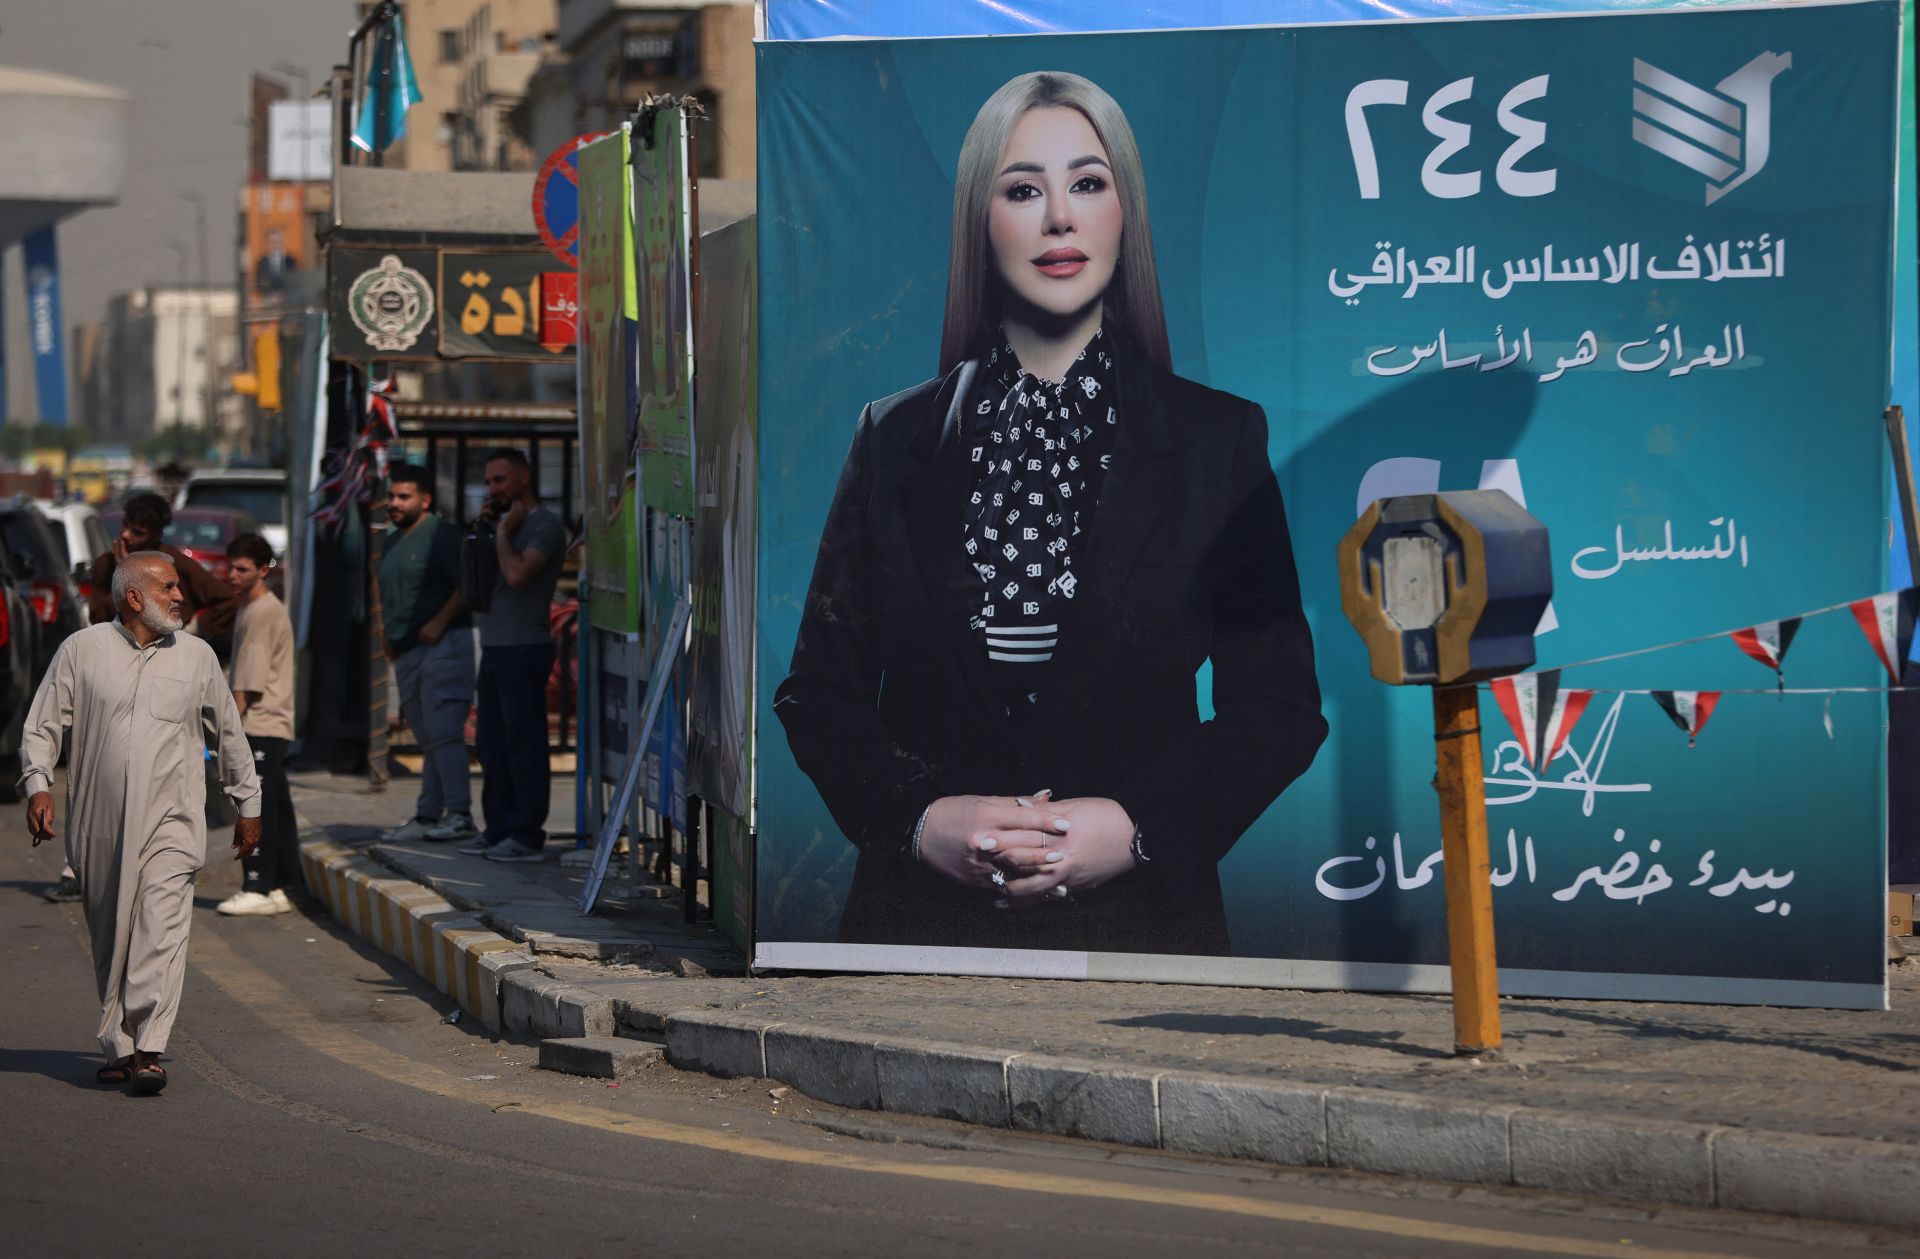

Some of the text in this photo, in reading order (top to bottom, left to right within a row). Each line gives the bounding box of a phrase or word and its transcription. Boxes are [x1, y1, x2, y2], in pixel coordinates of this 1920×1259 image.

[1344, 74, 1557, 199] ٢٤٤
[458, 270, 540, 337] ادة
[546, 291, 578, 318] وف
[1328, 233, 1785, 306] ائتلاف الاساس العراقي
[1367, 324, 1746, 382] العراق هو الأساس
[1571, 517, 1749, 580] التسلسل
[1315, 827, 1537, 901] المان
[1551, 828, 1674, 906] خضر
